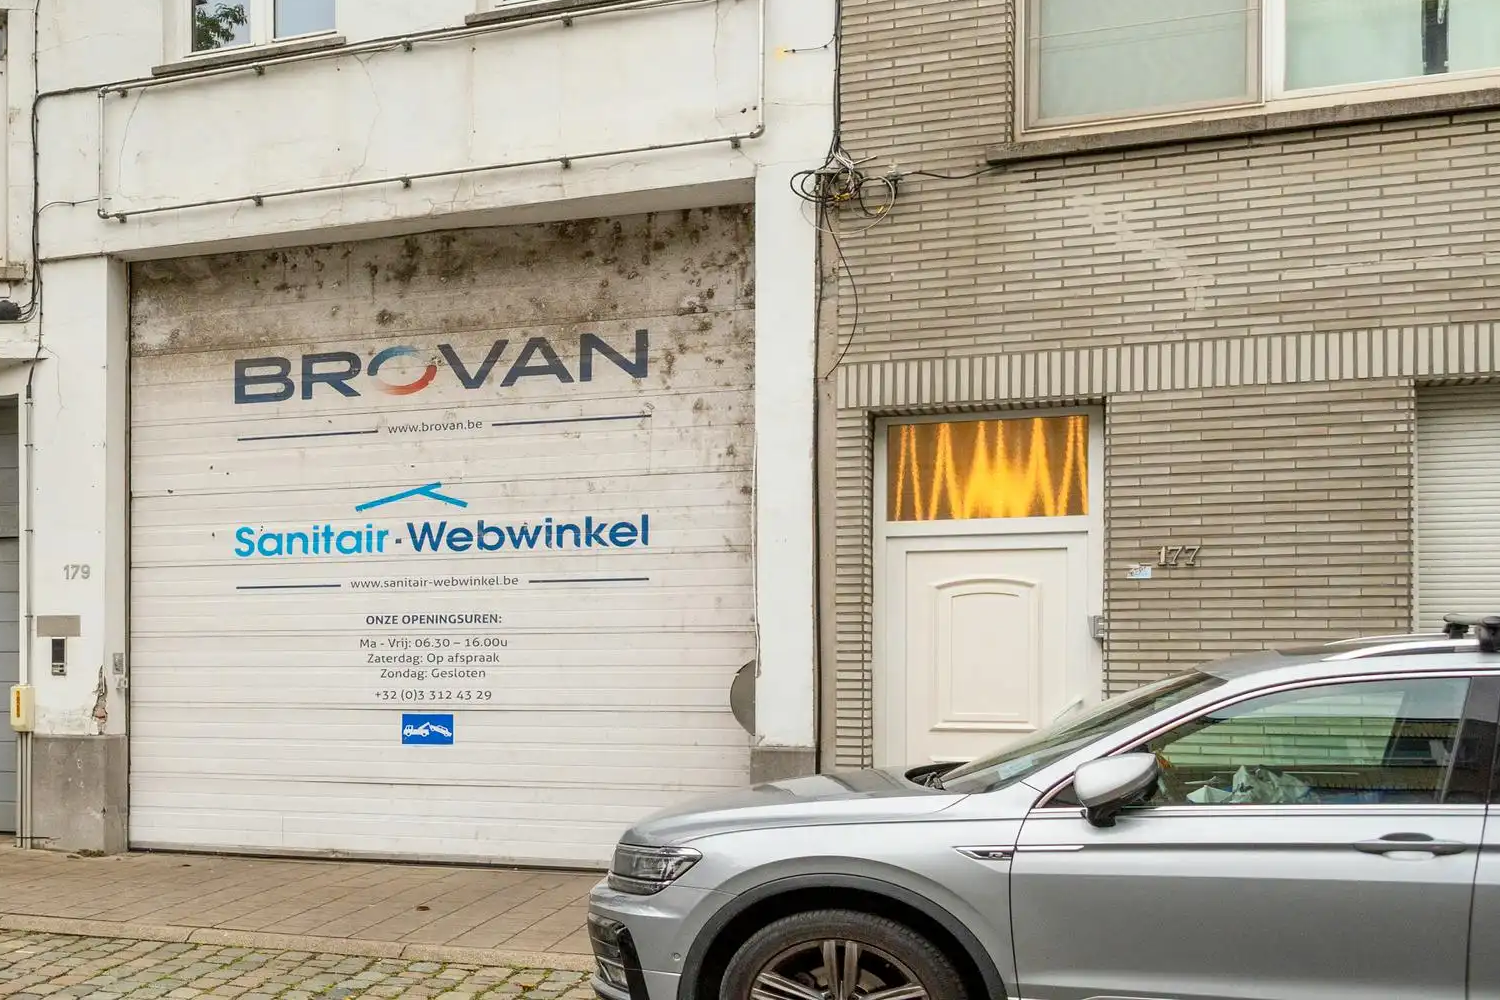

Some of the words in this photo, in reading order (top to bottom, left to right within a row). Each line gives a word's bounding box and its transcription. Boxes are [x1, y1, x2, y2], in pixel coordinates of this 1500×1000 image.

[234, 329, 649, 404] BROVAN
[388, 418, 484, 434] www.brovan.be
[1158, 545, 1200, 567] 177
[63, 564, 91, 580] 179
[350, 574, 519, 589] www.sanitair-webwinkel.be
[366, 615, 399, 625] ONZE
[401, 613, 502, 625] OPENINGSUREN:
[359, 638, 377, 649] Ma
[388, 638, 412, 650] Vrij:
[415, 638, 450, 648] 06.30
[465, 636, 508, 648] 16.00u
[367, 653, 423, 665] Zaterdag:
[426, 653, 444, 665] Op
[447, 652, 500, 665] afspraak
[380, 668, 428, 681] Zondag:
[431, 667, 486, 679] Gesloten
[375, 690, 397, 700] +32
[400, 690, 425, 701] (0)3
[429, 690, 452, 700] 312
[456, 690, 472, 700] 43
[476, 690, 492, 700] 29
